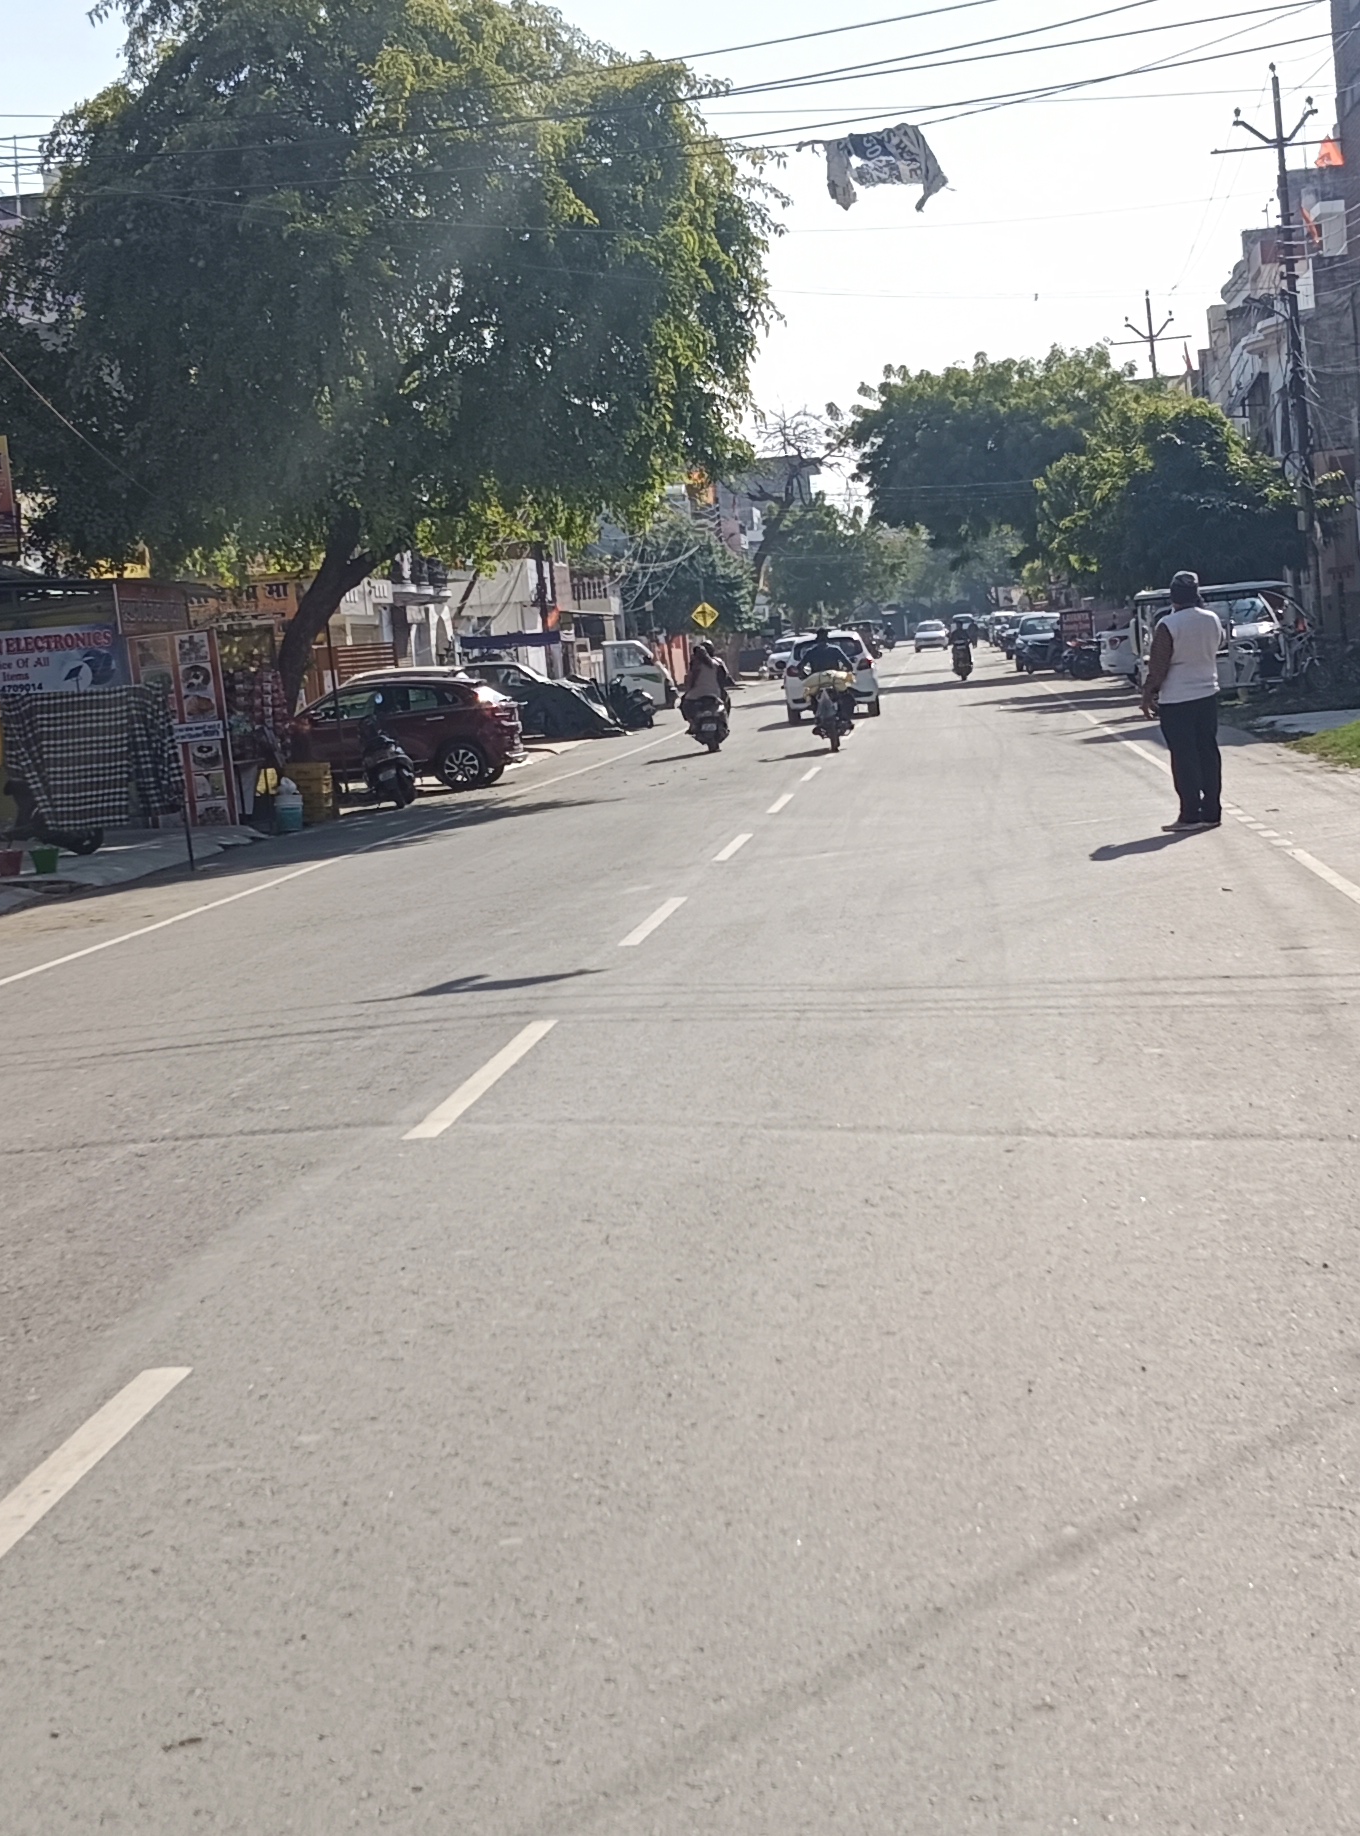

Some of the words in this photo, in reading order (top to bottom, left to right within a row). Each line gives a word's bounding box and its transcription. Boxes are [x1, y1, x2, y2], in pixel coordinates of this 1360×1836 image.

[6, 629, 112, 655] ELECTRONICS
[16, 658, 30, 669] Of
[33, 656, 50, 668] All
[2, 672, 30, 682] Items
